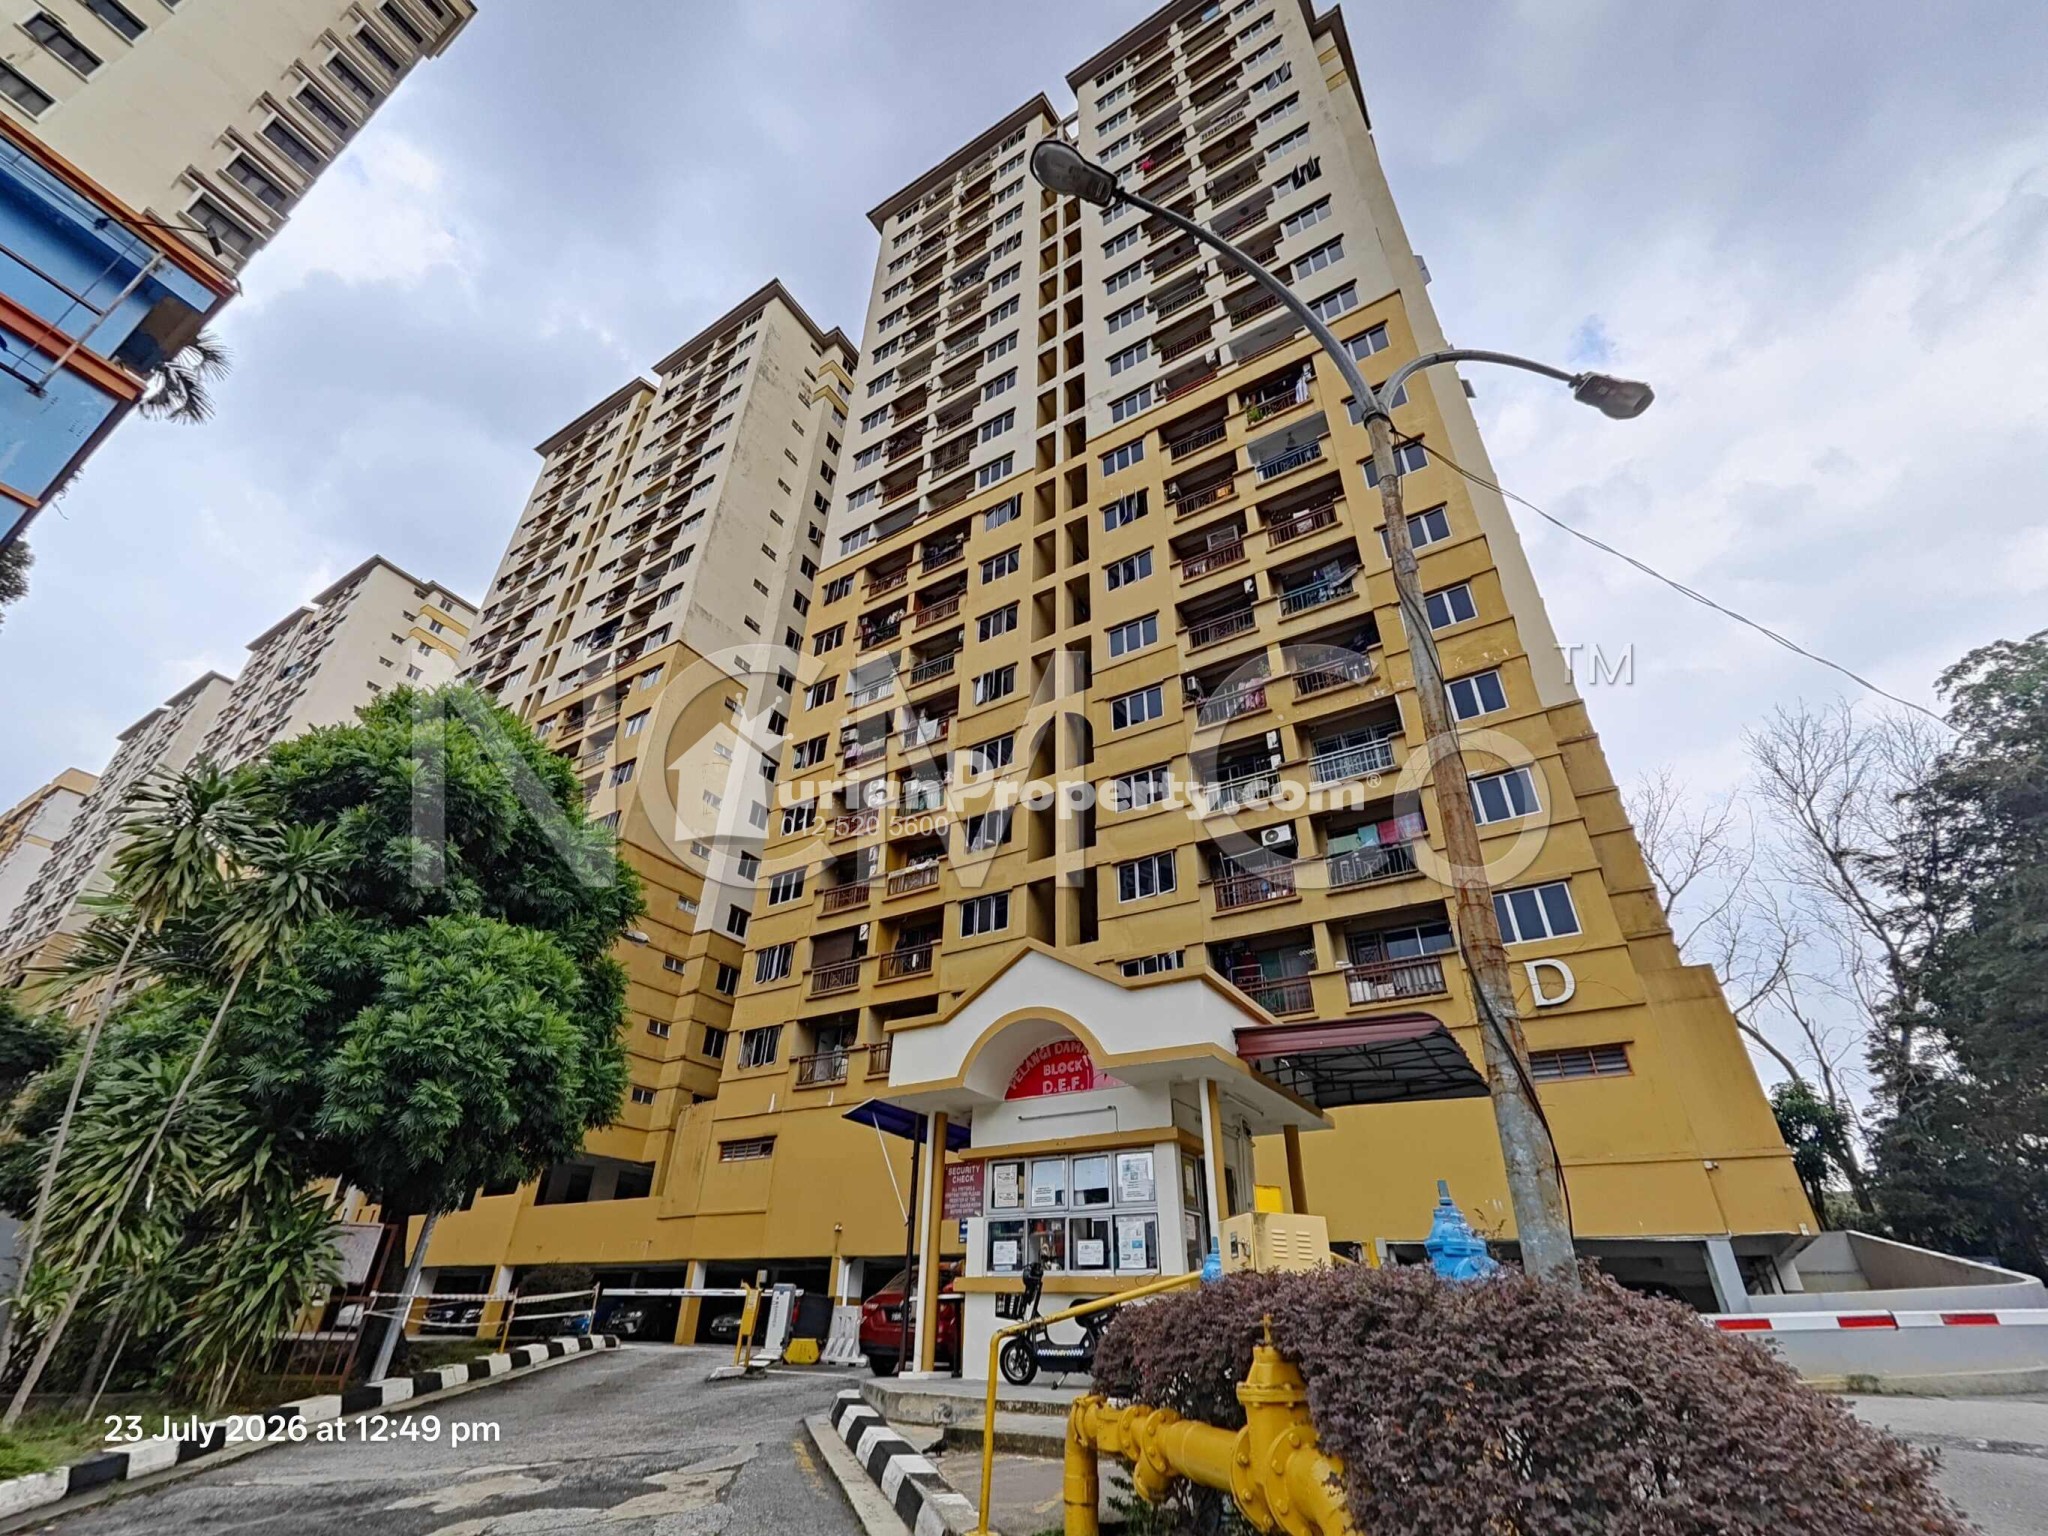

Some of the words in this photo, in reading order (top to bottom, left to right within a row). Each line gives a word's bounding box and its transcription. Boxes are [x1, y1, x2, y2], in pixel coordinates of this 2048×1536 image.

[1523, 958, 1575, 1007] D
[1043, 1058, 1083, 1076] BLOCK
[1042, 1076, 1084, 1095] D.E.F.
[948, 1165, 981, 1176] SECURITY
[952, 1174, 975, 1184] CHECK
